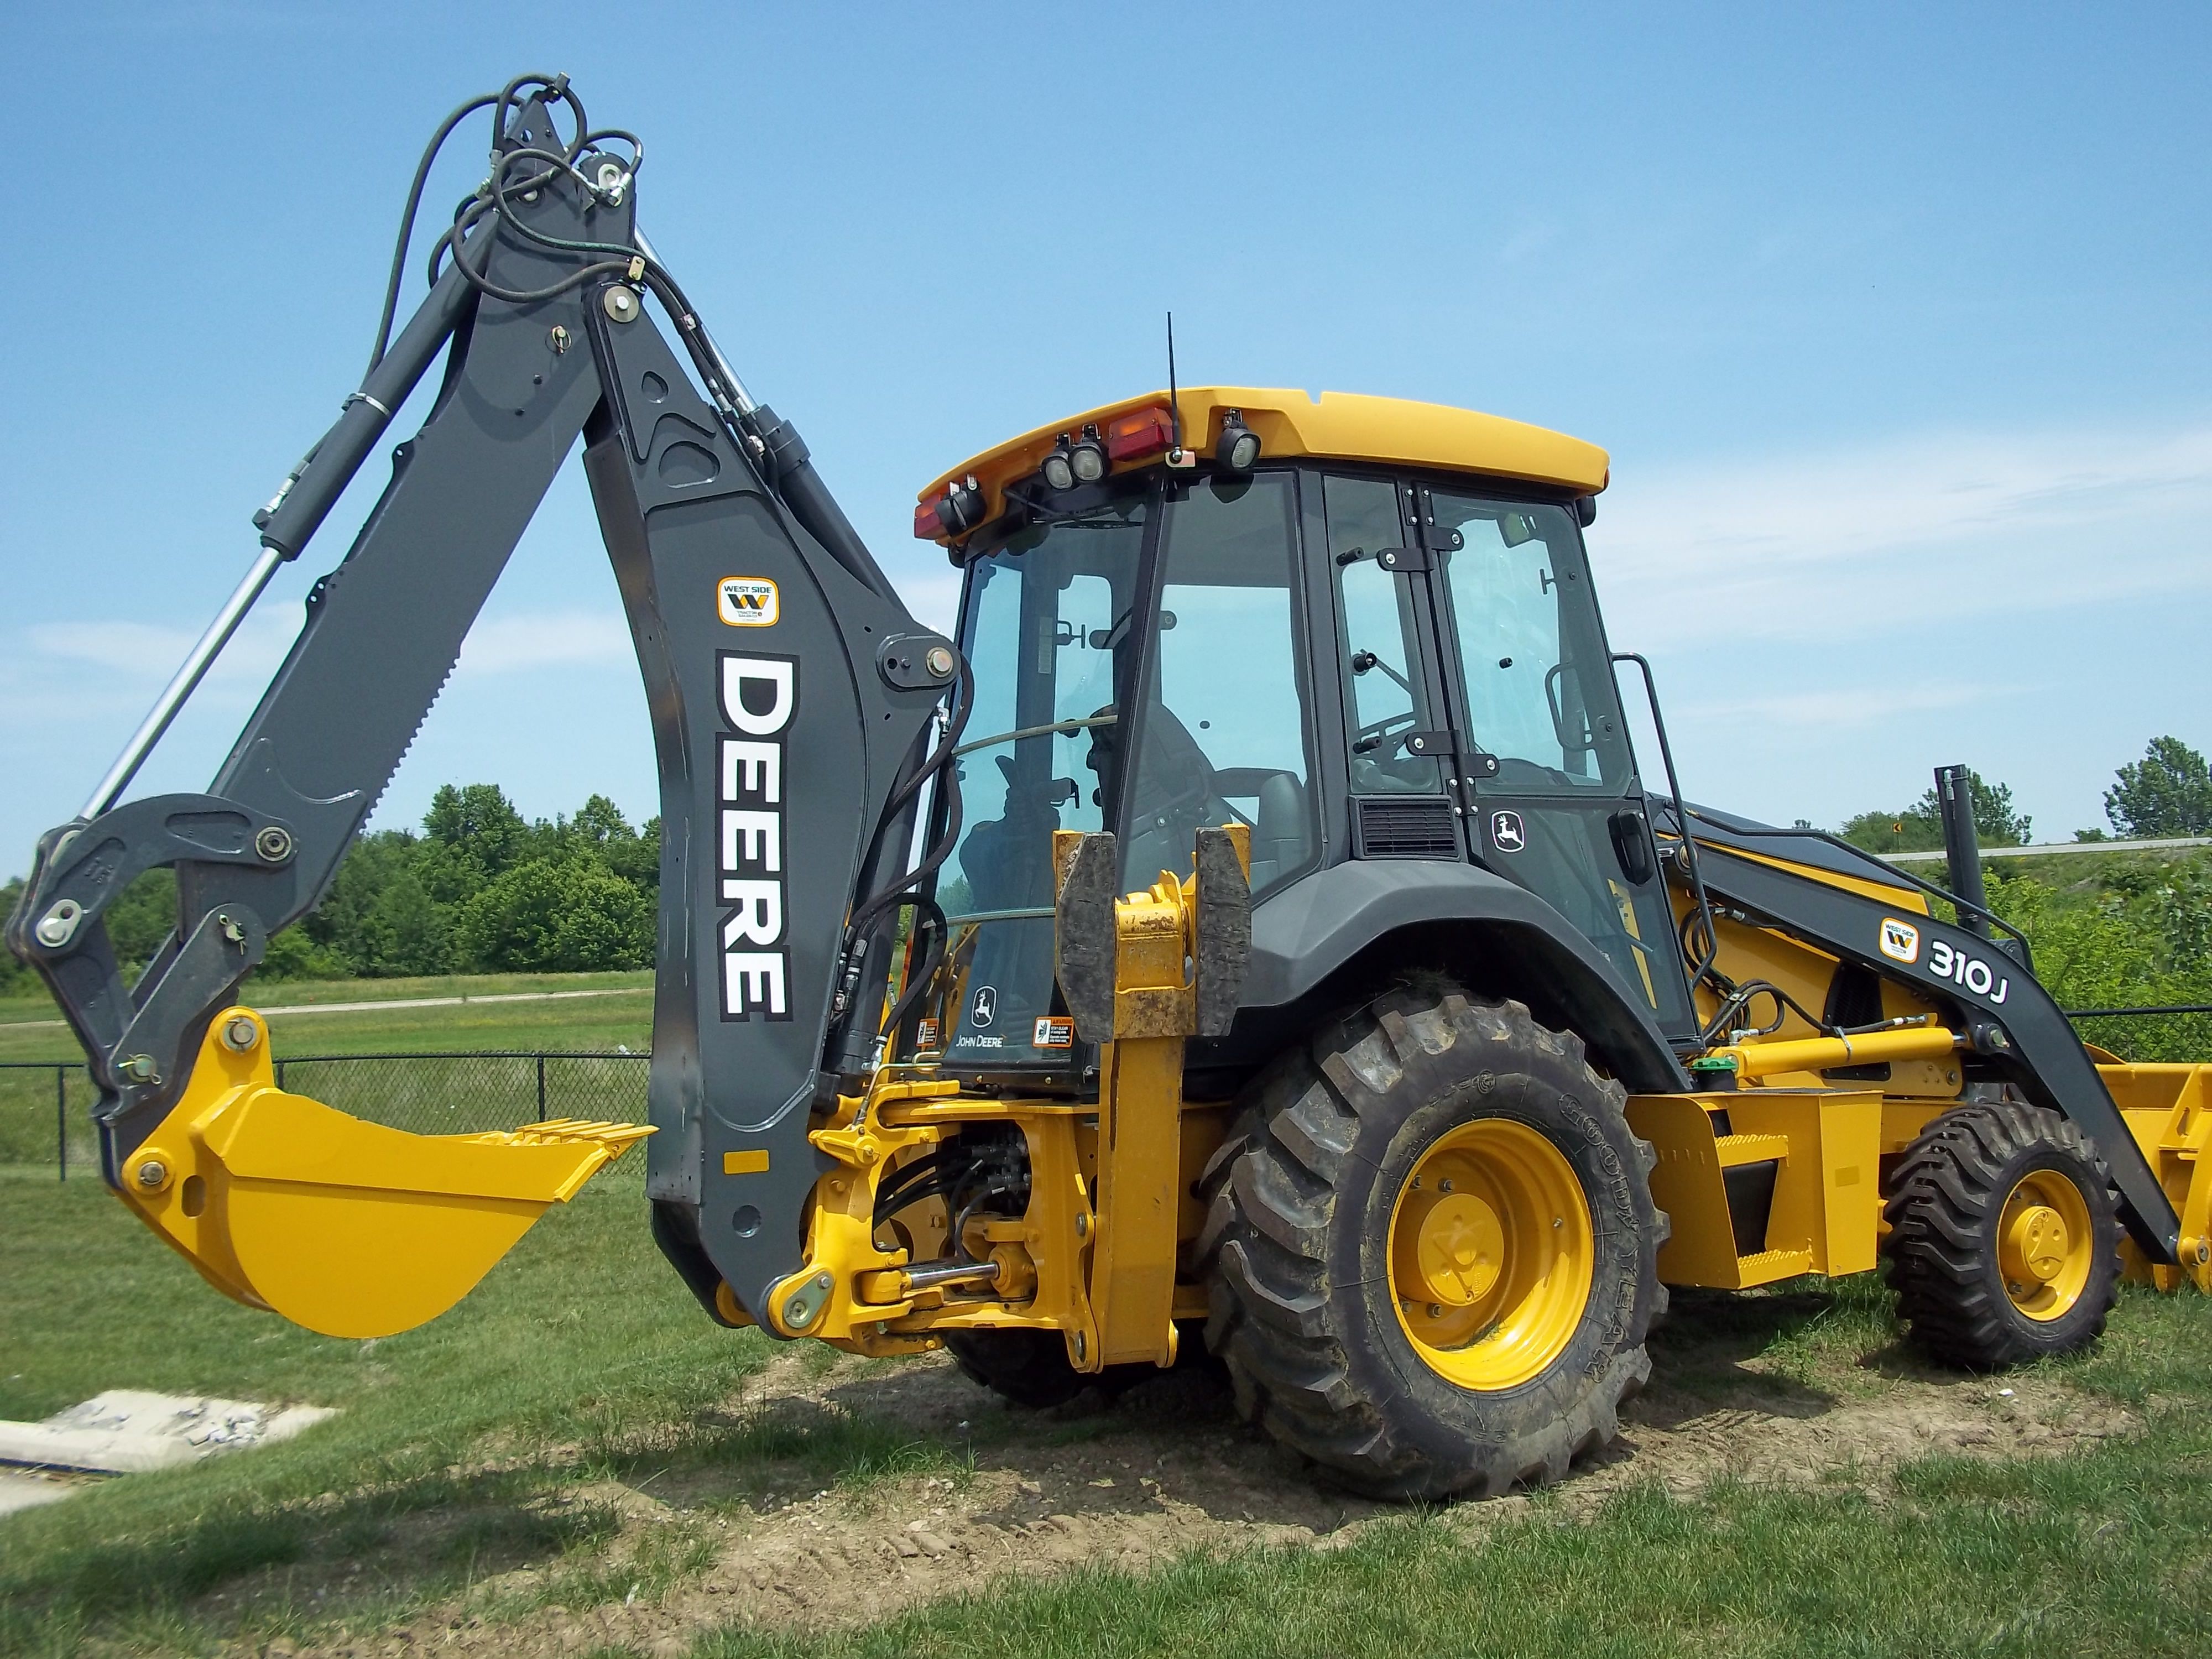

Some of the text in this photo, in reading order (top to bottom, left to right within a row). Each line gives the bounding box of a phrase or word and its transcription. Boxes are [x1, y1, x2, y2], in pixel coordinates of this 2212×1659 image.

[722, 656, 794, 1014] DEERE
[1885, 924, 1915, 938] WEST SIDE
[1929, 941, 2008, 1004] 310J
[956, 1035, 1003, 1047] JOHN DEERE
[1558, 1093, 1642, 1384] GOODYEAR
